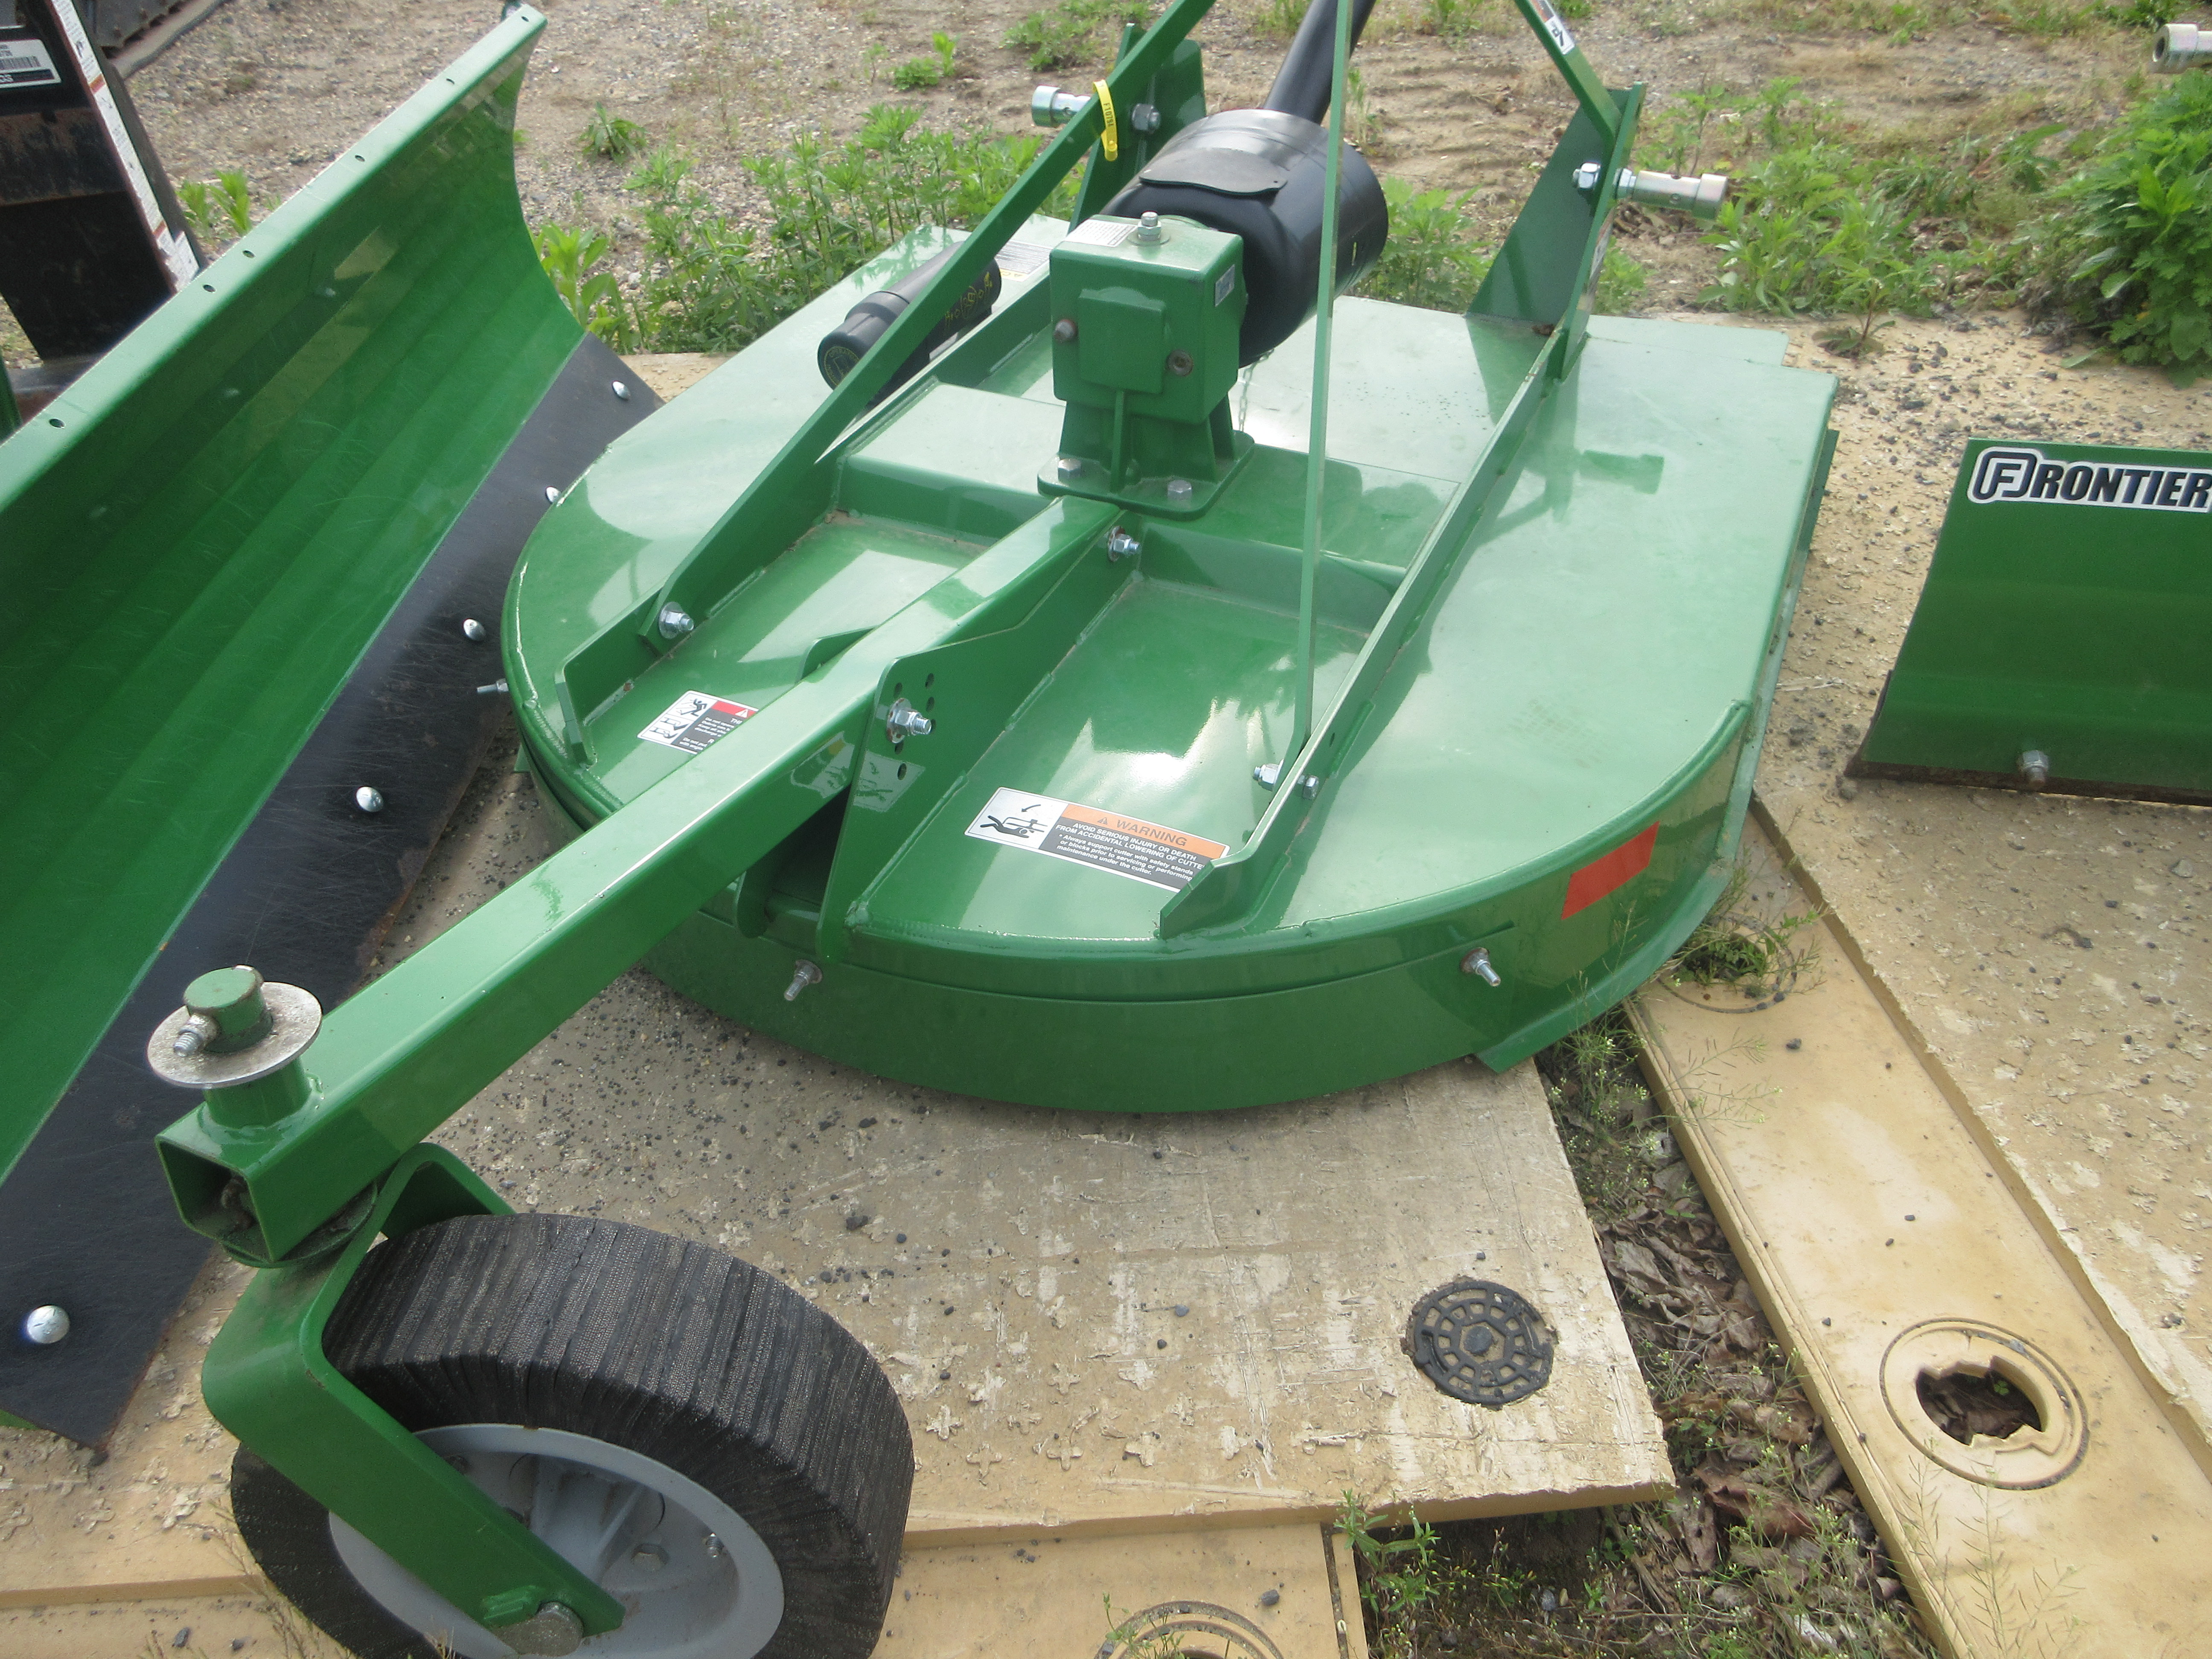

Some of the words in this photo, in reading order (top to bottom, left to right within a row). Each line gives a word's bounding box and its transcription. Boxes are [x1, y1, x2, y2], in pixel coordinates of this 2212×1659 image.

[1972, 451, 2212, 508] FRONTIER
[1055, 824, 1078, 834] FROM
[1077, 830, 1123, 847] ACCIDENTAL
[1124, 840, 1164, 858] LOWERING
[1073, 823, 1096, 832] AVOID
[1096, 829, 1130, 841] SERIOUS
[1130, 838, 1158, 849] INJURY
[1171, 849, 1197, 861] DEATH
[1117, 819, 1187, 846] WARNING
[1056, 844, 1098, 859] maintenance
[1099, 856, 1119, 865] under
[1131, 866, 1152, 875] cutter.
[1063, 835, 1087, 844] Always
[1088, 841, 1113, 852] support
[1114, 848, 1135, 857] cutter
[1134, 853, 1149, 862] with
[1149, 859, 1170, 869] safety
[1170, 865, 1193, 875] stands
[1069, 841, 1090, 851] blocks
[1090, 848, 1108, 856] prior
[1116, 855, 1147, 867] servicing
[1155, 866, 1193, 882] performing
